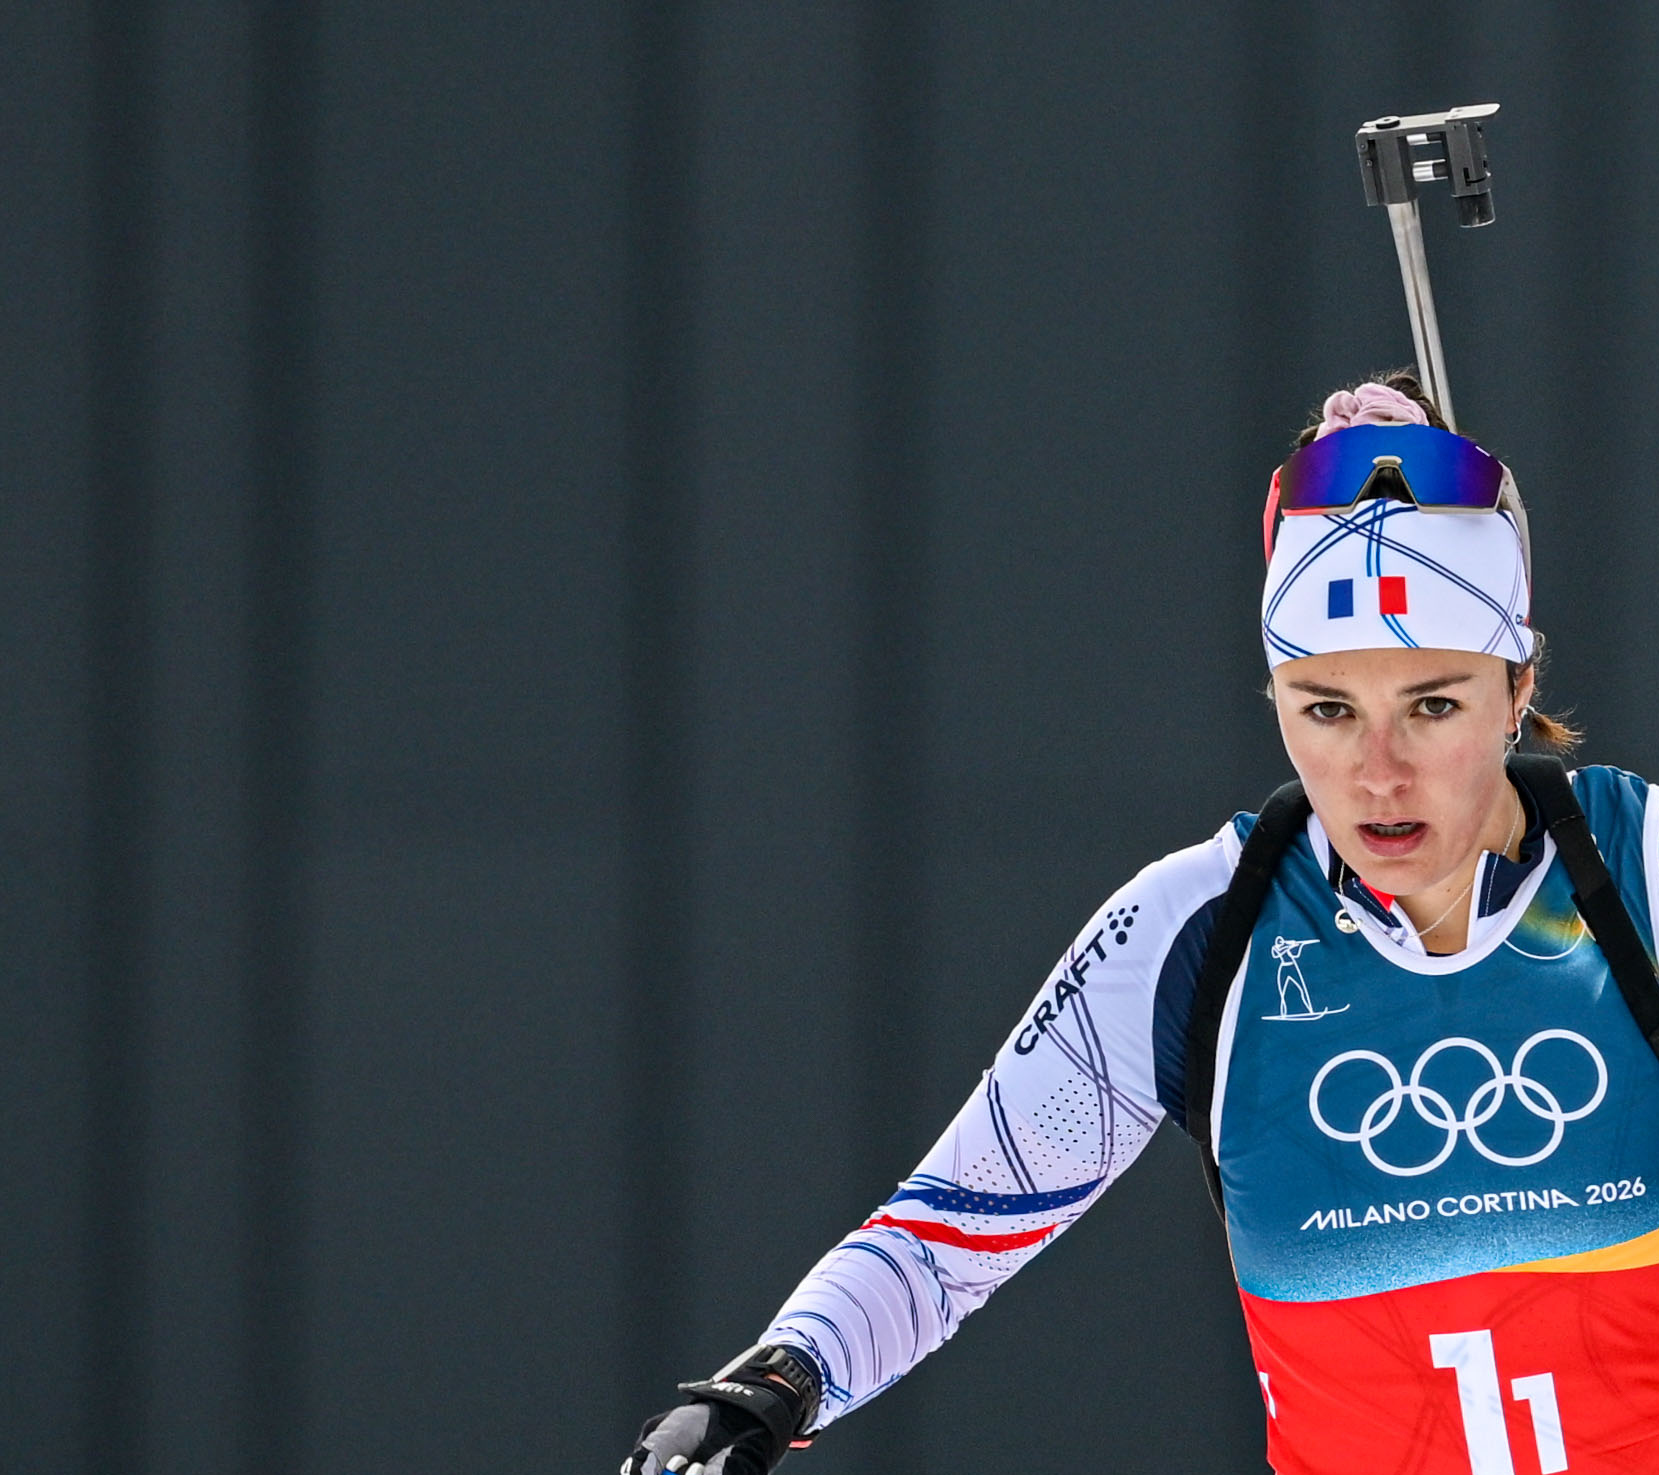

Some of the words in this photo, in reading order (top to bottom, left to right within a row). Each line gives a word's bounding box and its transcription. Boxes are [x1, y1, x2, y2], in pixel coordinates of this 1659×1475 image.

[1014, 928, 1107, 1056] CRAFT
[1300, 1201, 1430, 1231] MILANO
[1436, 1189, 1579, 1217] CORTINA
[1585, 1177, 1647, 1205] 2026
